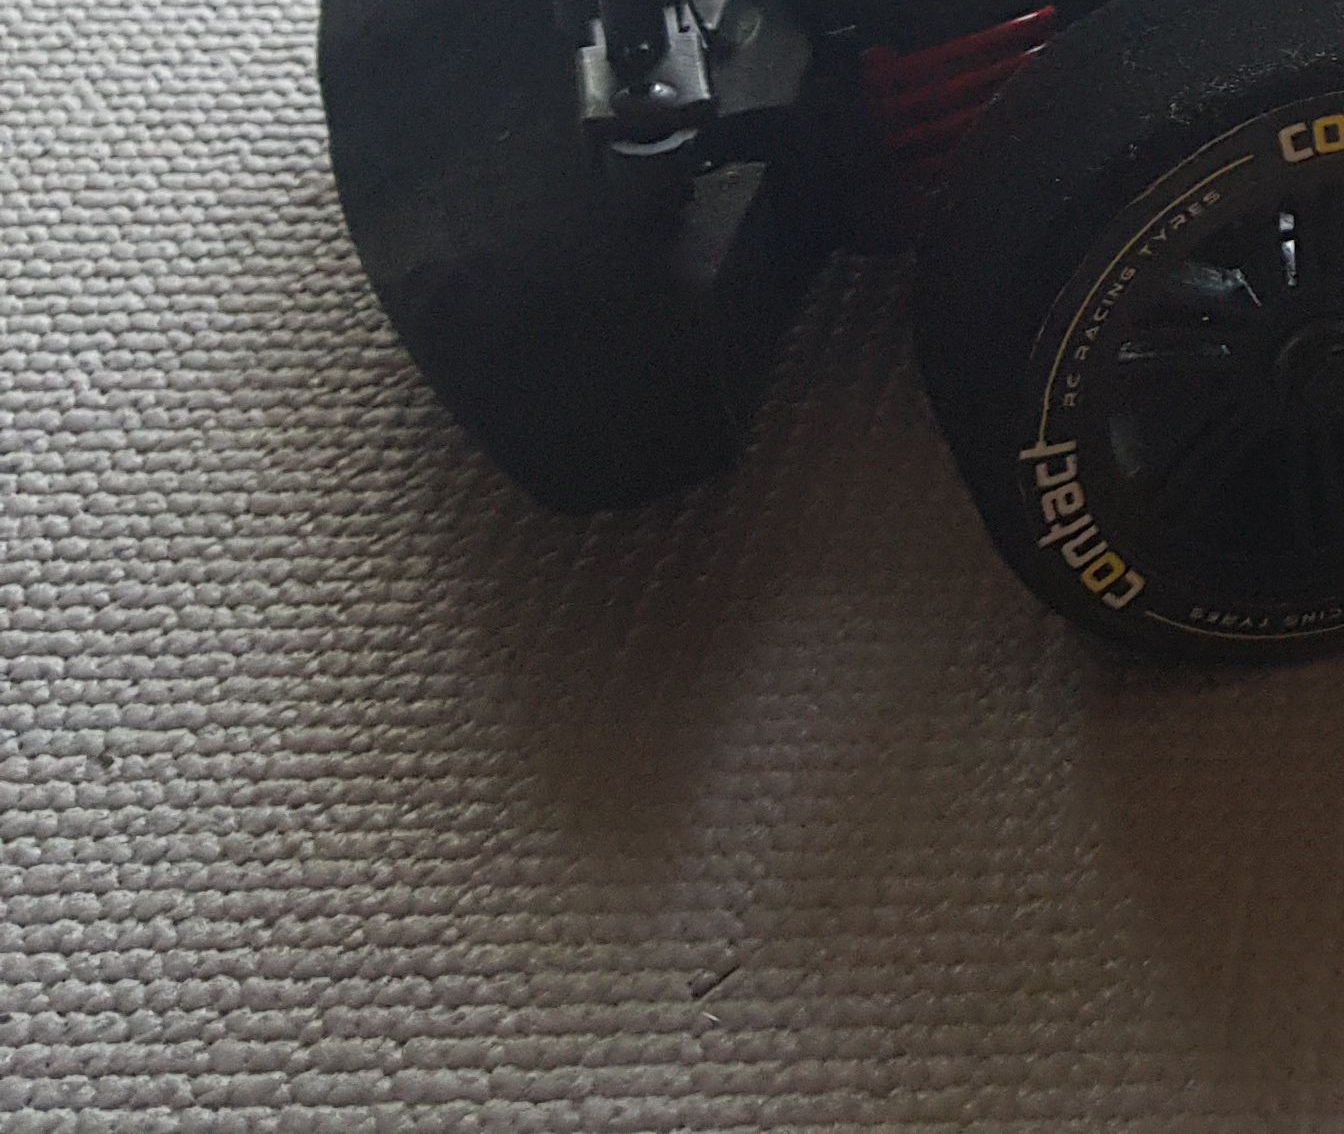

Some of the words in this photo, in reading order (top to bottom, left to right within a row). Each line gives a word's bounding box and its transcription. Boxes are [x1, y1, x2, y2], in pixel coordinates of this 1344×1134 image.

[1063, 373, 1081, 407] RC
[1074, 266, 1137, 360] RACING
[1138, 190, 1221, 255] TYRES
[1018, 440, 1146, 610] contact
